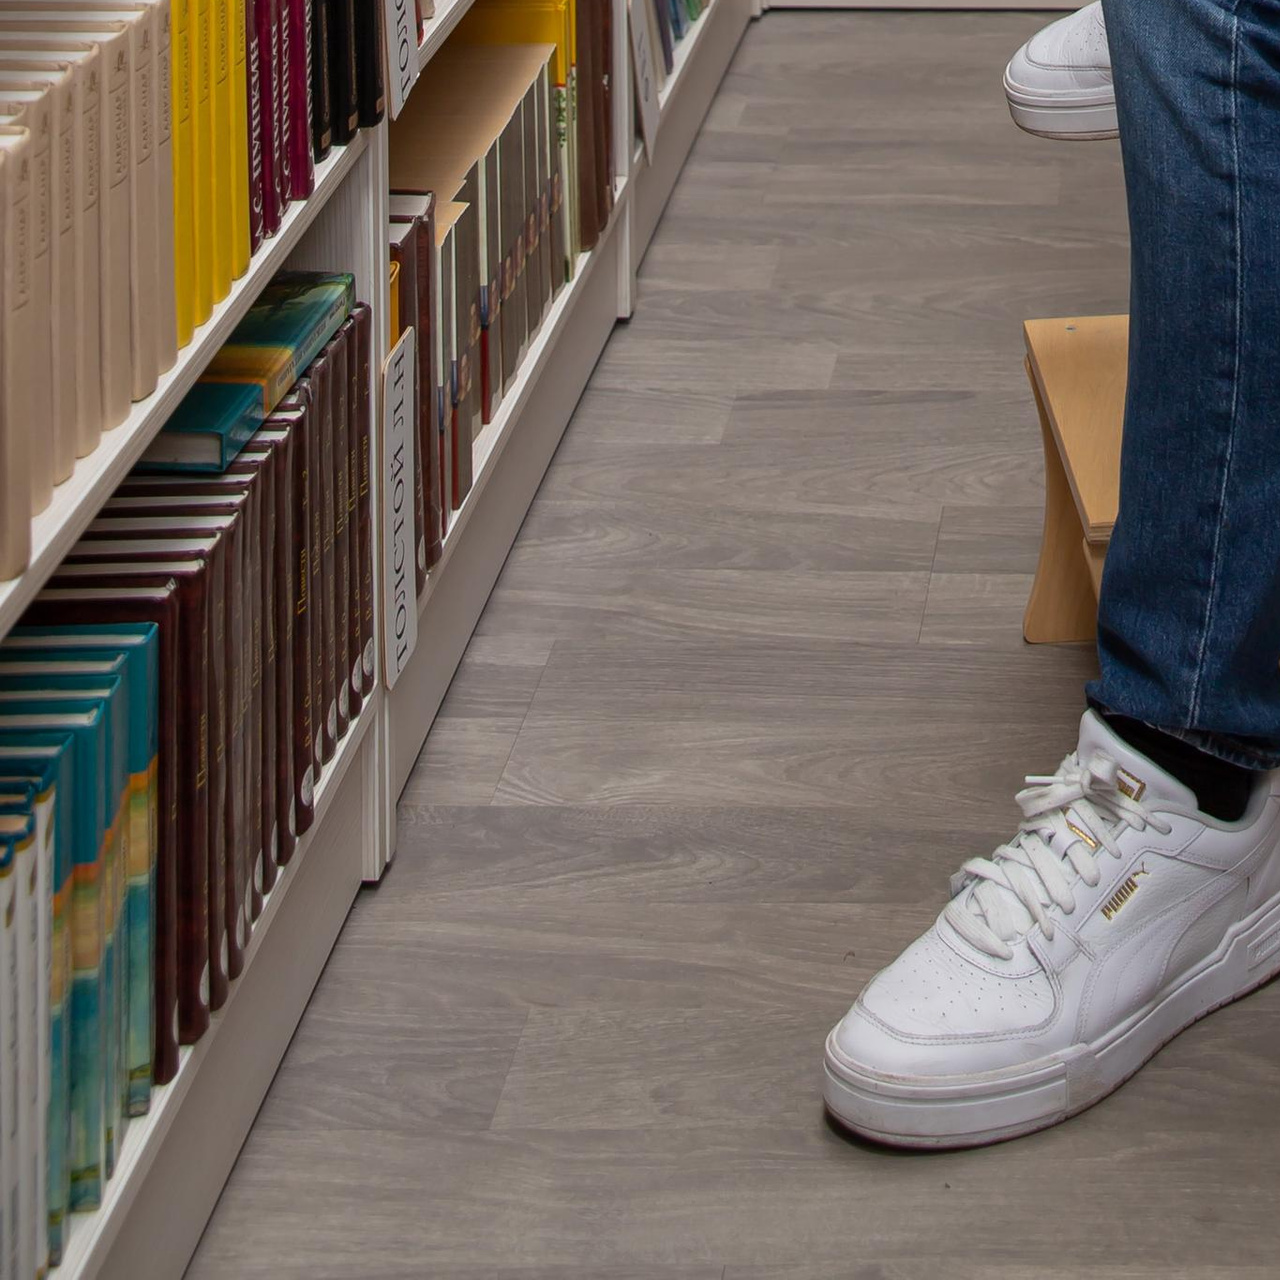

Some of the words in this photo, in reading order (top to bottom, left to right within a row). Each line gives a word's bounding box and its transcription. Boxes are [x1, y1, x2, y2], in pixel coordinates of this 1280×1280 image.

[250, 35, 263, 181] ПУШКИН
[391, 442, 409, 674] ТОЛСТОЙ
[1100, 876, 1139, 921] PUMA
